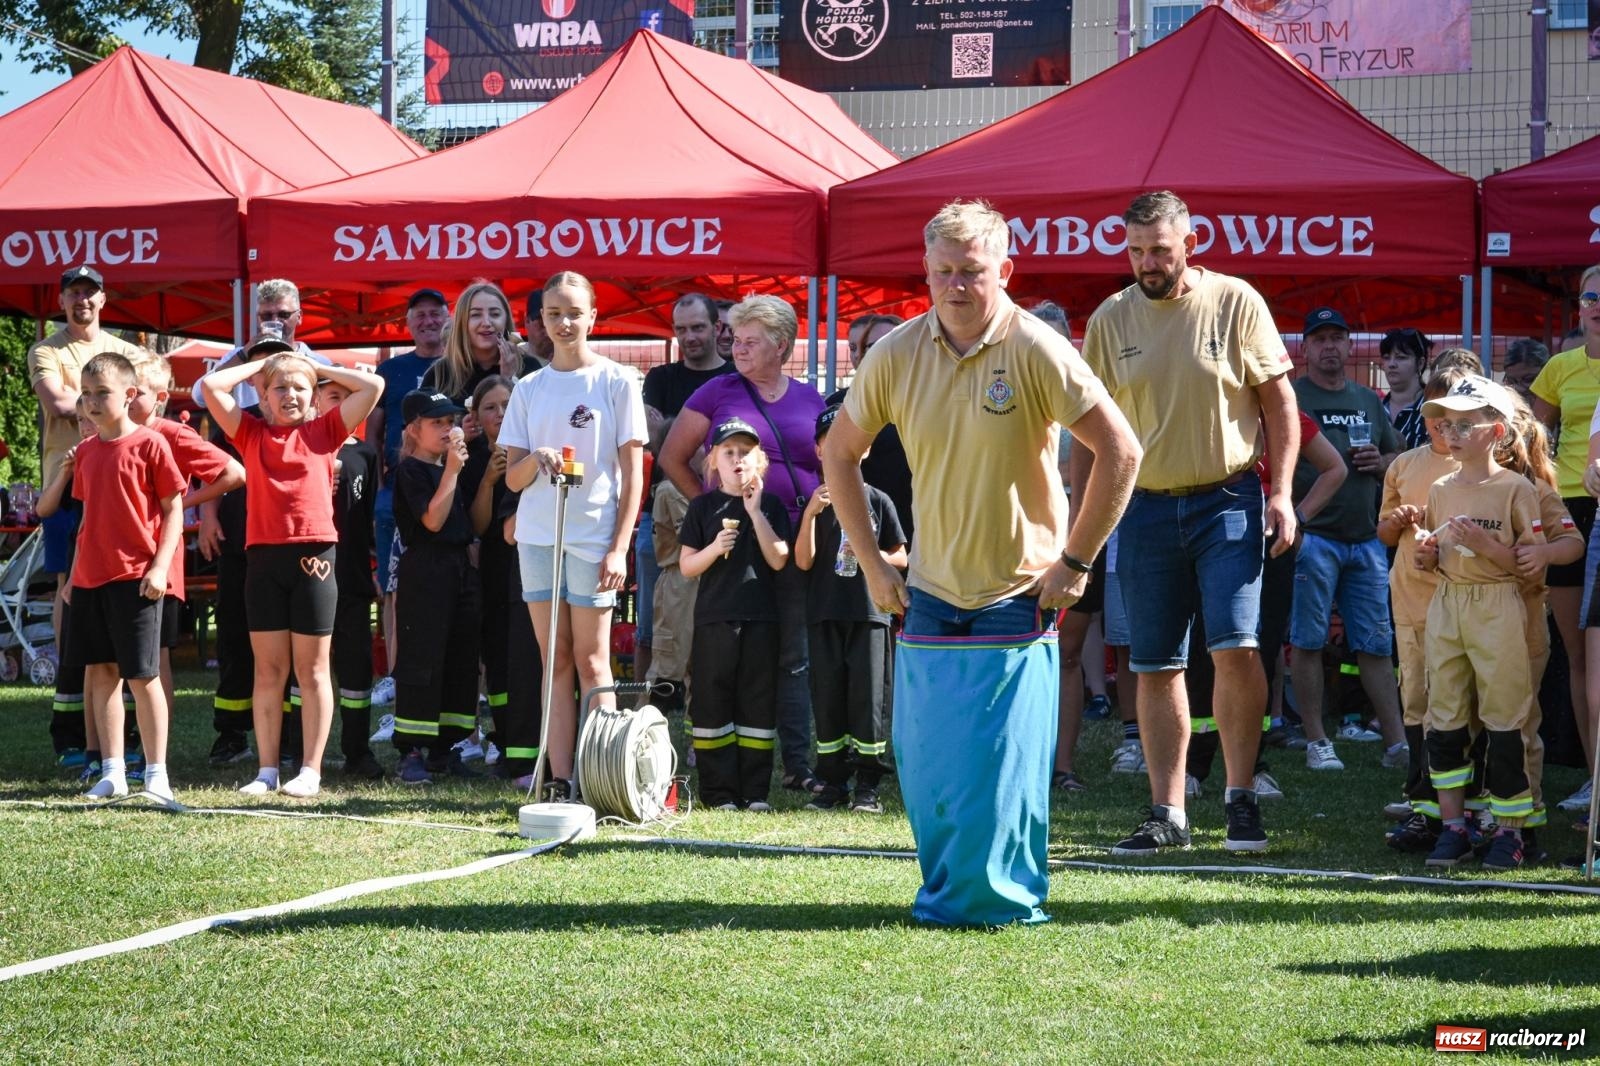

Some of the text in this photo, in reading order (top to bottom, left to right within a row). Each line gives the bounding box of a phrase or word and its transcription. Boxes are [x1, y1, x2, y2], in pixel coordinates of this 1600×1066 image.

[816, 15, 875, 24] HORYZONT
[826, 7, 864, 15] PONAD
[960, 10, 1008, 19] 502-158-557
[513, 20, 603, 48] WRBA
[1271, 20, 1349, 45] ARIUM
[1319, 47, 1415, 73] FRYZUR
[0, 228, 160, 267] OWICE
[333, 217, 723, 262] SAMBOROWICE
